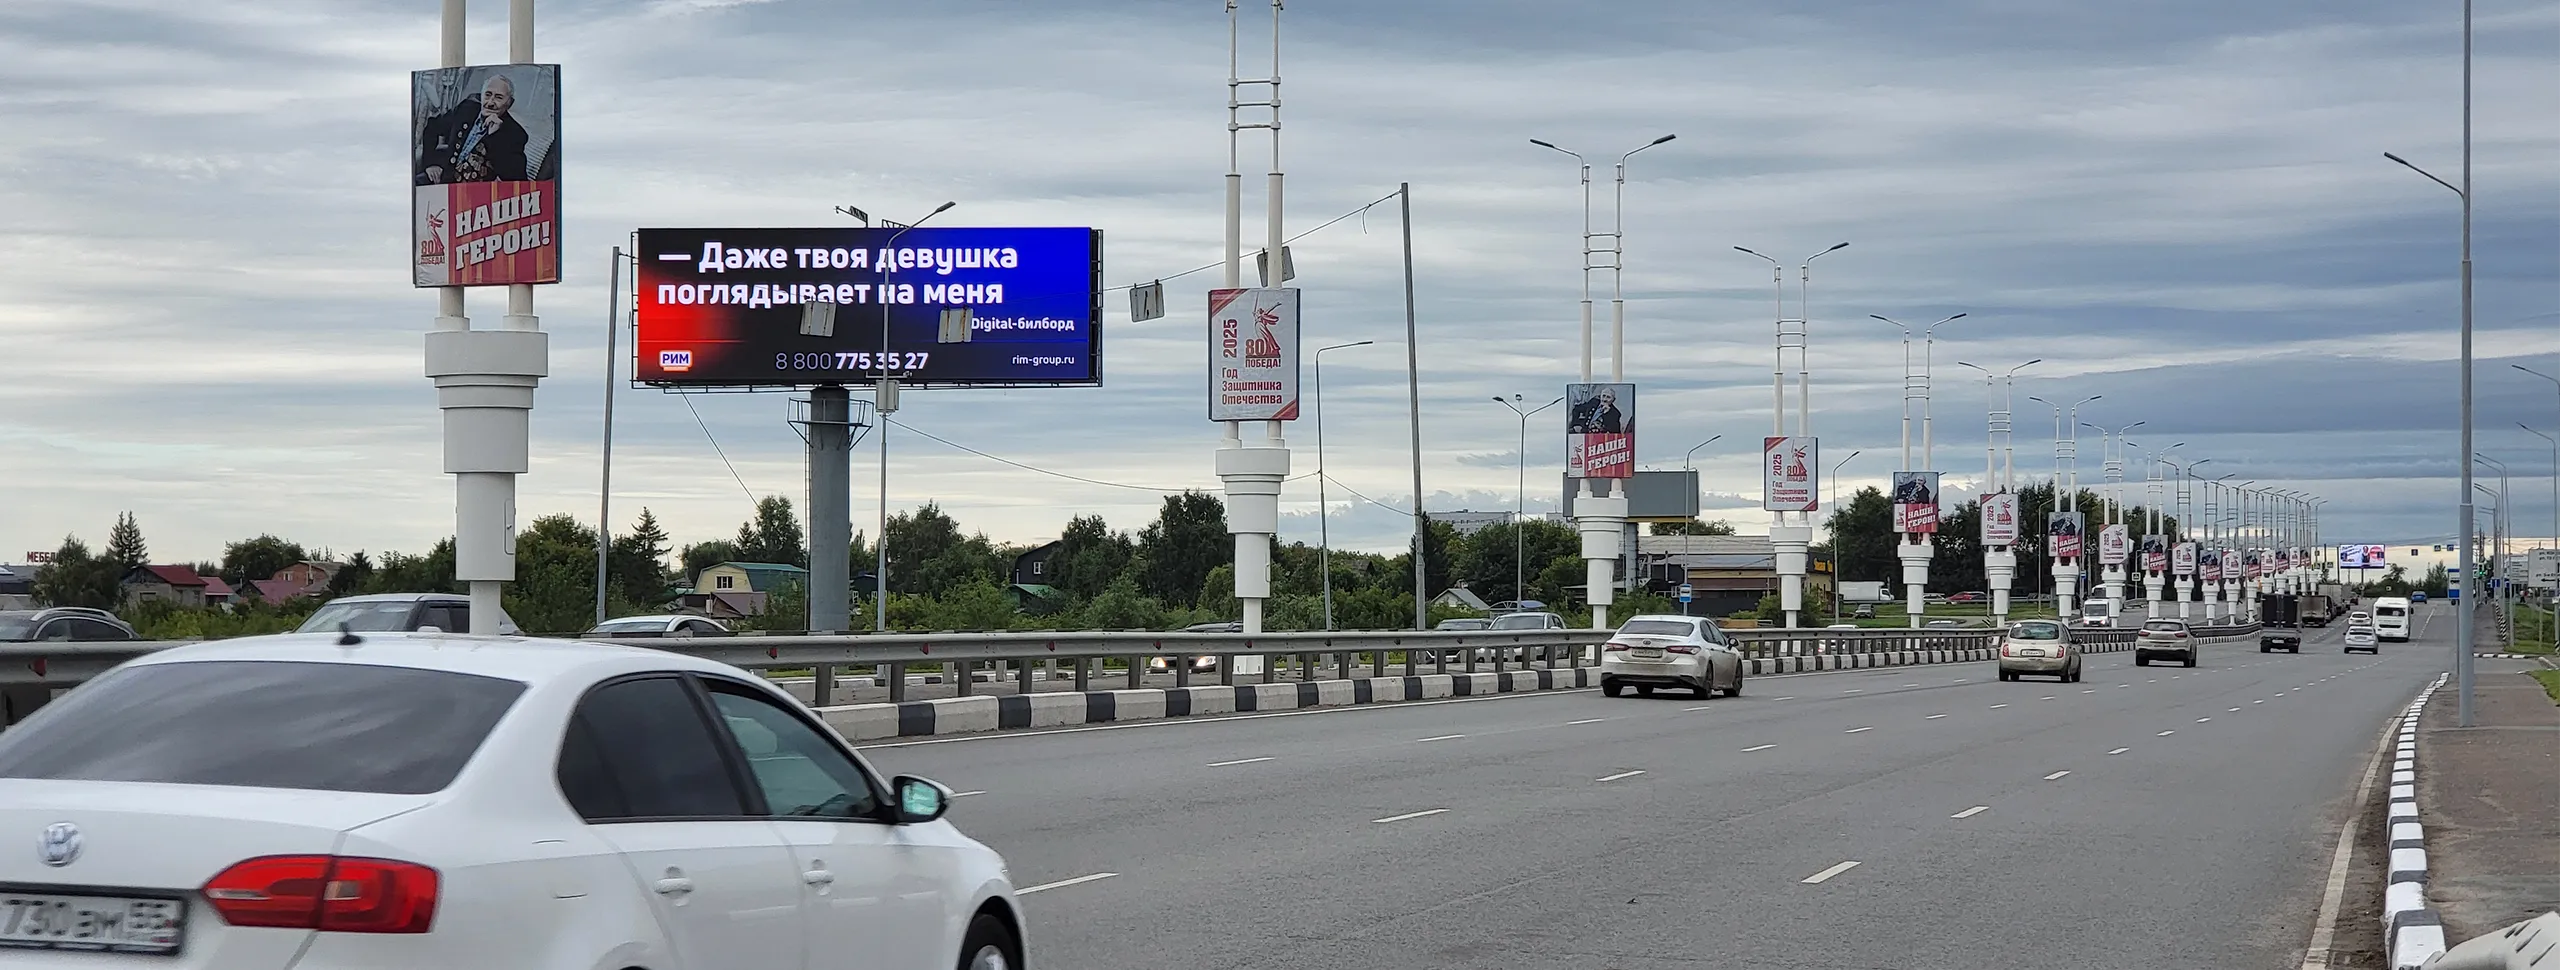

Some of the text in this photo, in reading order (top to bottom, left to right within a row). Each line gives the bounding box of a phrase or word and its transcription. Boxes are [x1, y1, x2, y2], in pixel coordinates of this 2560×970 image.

[455, 190, 541, 238] НАШИ
[421, 241, 433, 255] 80
[455, 221, 550, 270] ГЕРОИ!
[699, 242, 788, 273] Даже
[795, 248, 867, 268] твоя
[875, 247, 1018, 275] девушка
[658, 284, 1003, 309] поглядывает на меня
[971, 317, 1075, 332] Digital-билборд
[1223, 319, 1238, 358] 2025
[1246, 338, 1265, 356] 80
[662, 353, 689, 364] РИМ
[775, 353, 929, 370] 8 800 775 35 27
[1012, 355, 1075, 366] rim-group.ru
[1246, 359, 1281, 368] ПОБЕДА!
[1222, 367, 1238, 379] Год
[1222, 380, 1282, 392] Защитника
[1222, 394, 1282, 405] Отечества
[1587, 437, 1626, 457] НАШИ
[1587, 451, 1630, 471] ГЕРОИ!
[1773, 454, 1782, 476] 2025
